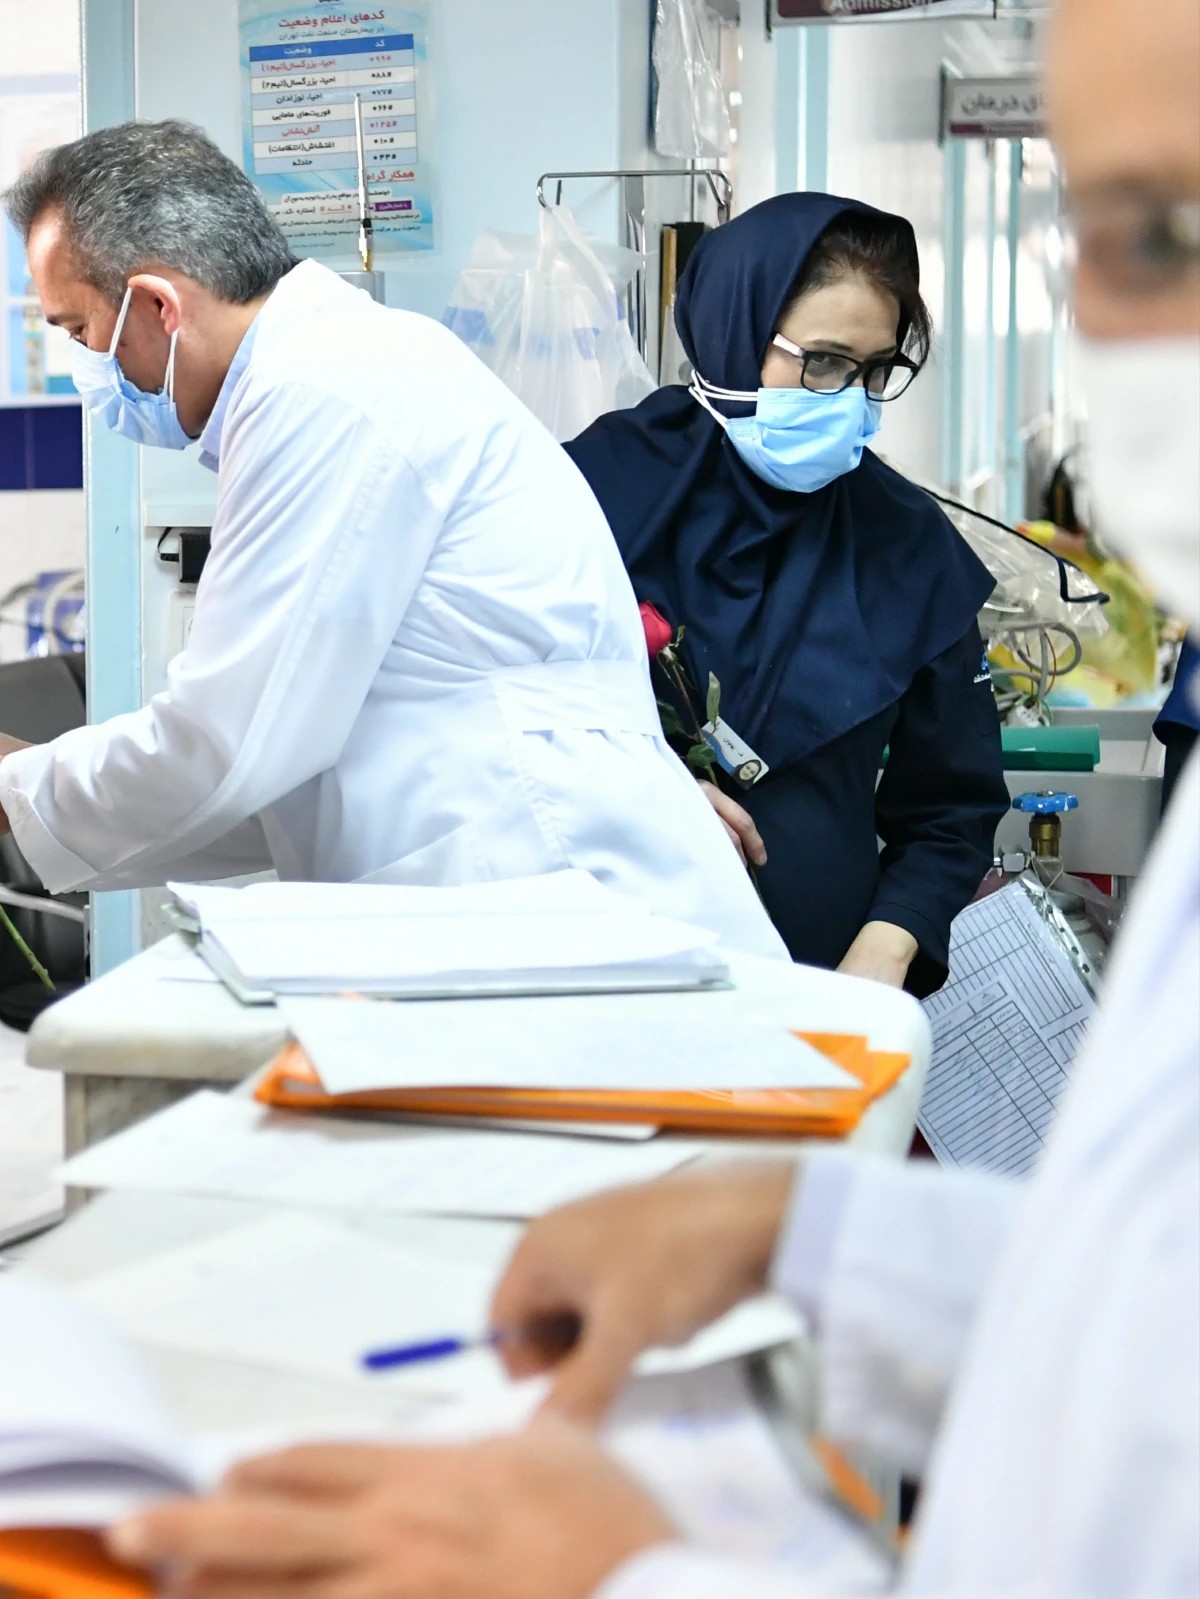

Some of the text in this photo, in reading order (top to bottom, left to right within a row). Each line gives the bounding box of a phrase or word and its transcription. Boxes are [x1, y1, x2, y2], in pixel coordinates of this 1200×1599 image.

[278, 9, 385, 30] کدهای اعلام وضعیت
[375, 40, 385, 48] کد
[284, 46, 312, 56] وضعیت
[388, 170, 415, 181] همکار
